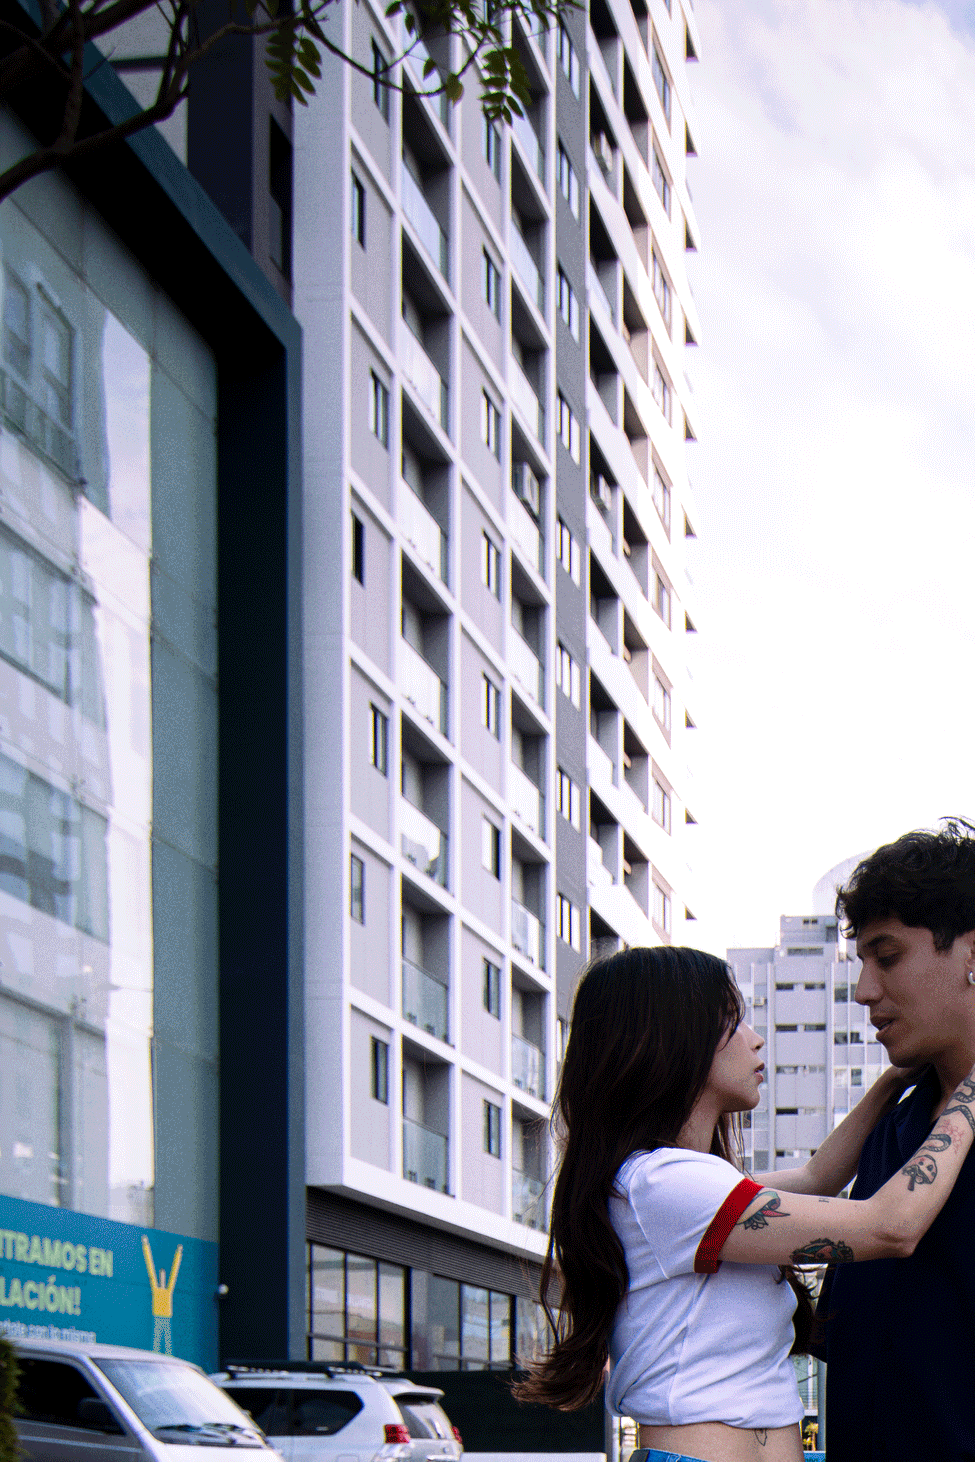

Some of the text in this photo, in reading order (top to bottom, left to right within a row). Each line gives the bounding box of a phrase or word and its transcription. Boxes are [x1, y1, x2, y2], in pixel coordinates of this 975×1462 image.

[0, 1228, 114, 1278] TRAMOS EN
[0, 1274, 81, 1316] LACIÓN!
